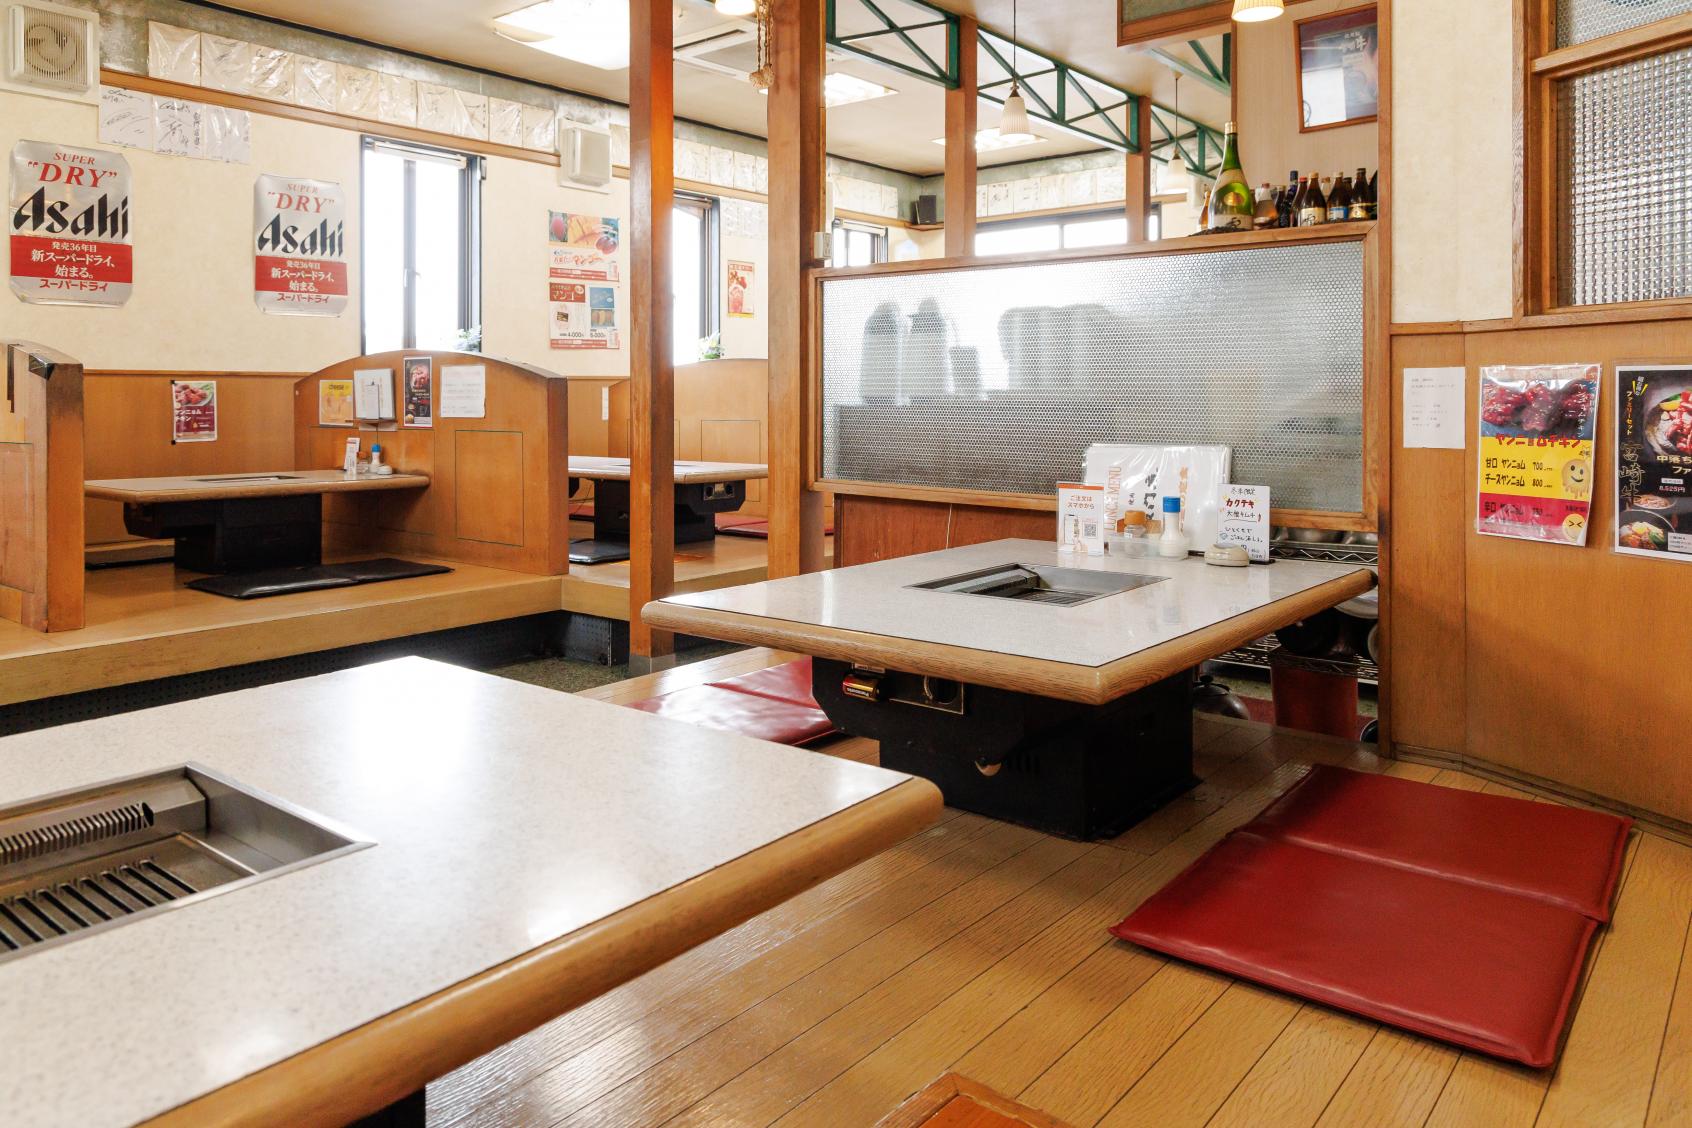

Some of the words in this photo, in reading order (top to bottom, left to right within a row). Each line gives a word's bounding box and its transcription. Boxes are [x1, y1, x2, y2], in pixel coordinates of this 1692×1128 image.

[53, 152, 96, 165] SUPER
[287, 183, 319, 193] SUPER
[13, 186, 128, 240] Asahi
[257, 213, 343, 257] Asahi
[51, 241, 97, 253] 発売36年目
[31, 249, 115, 268] 新スーパードライ、
[55, 265, 94, 279] 始まる。
[271, 267, 335, 282] 新スーパードライ、
[39, 278, 109, 292] スーパードライ
[289, 280, 319, 292] 始まる。
[277, 292, 330, 304] スーパードライ
[1485, 458, 1498, 469] 甘口
[1501, 459, 1526, 470] ヤンニョム
[1532, 478, 1543, 488] 800
[1067, 502, 1095, 510] スマホから
[1226, 498, 1255, 509] カクテキ
